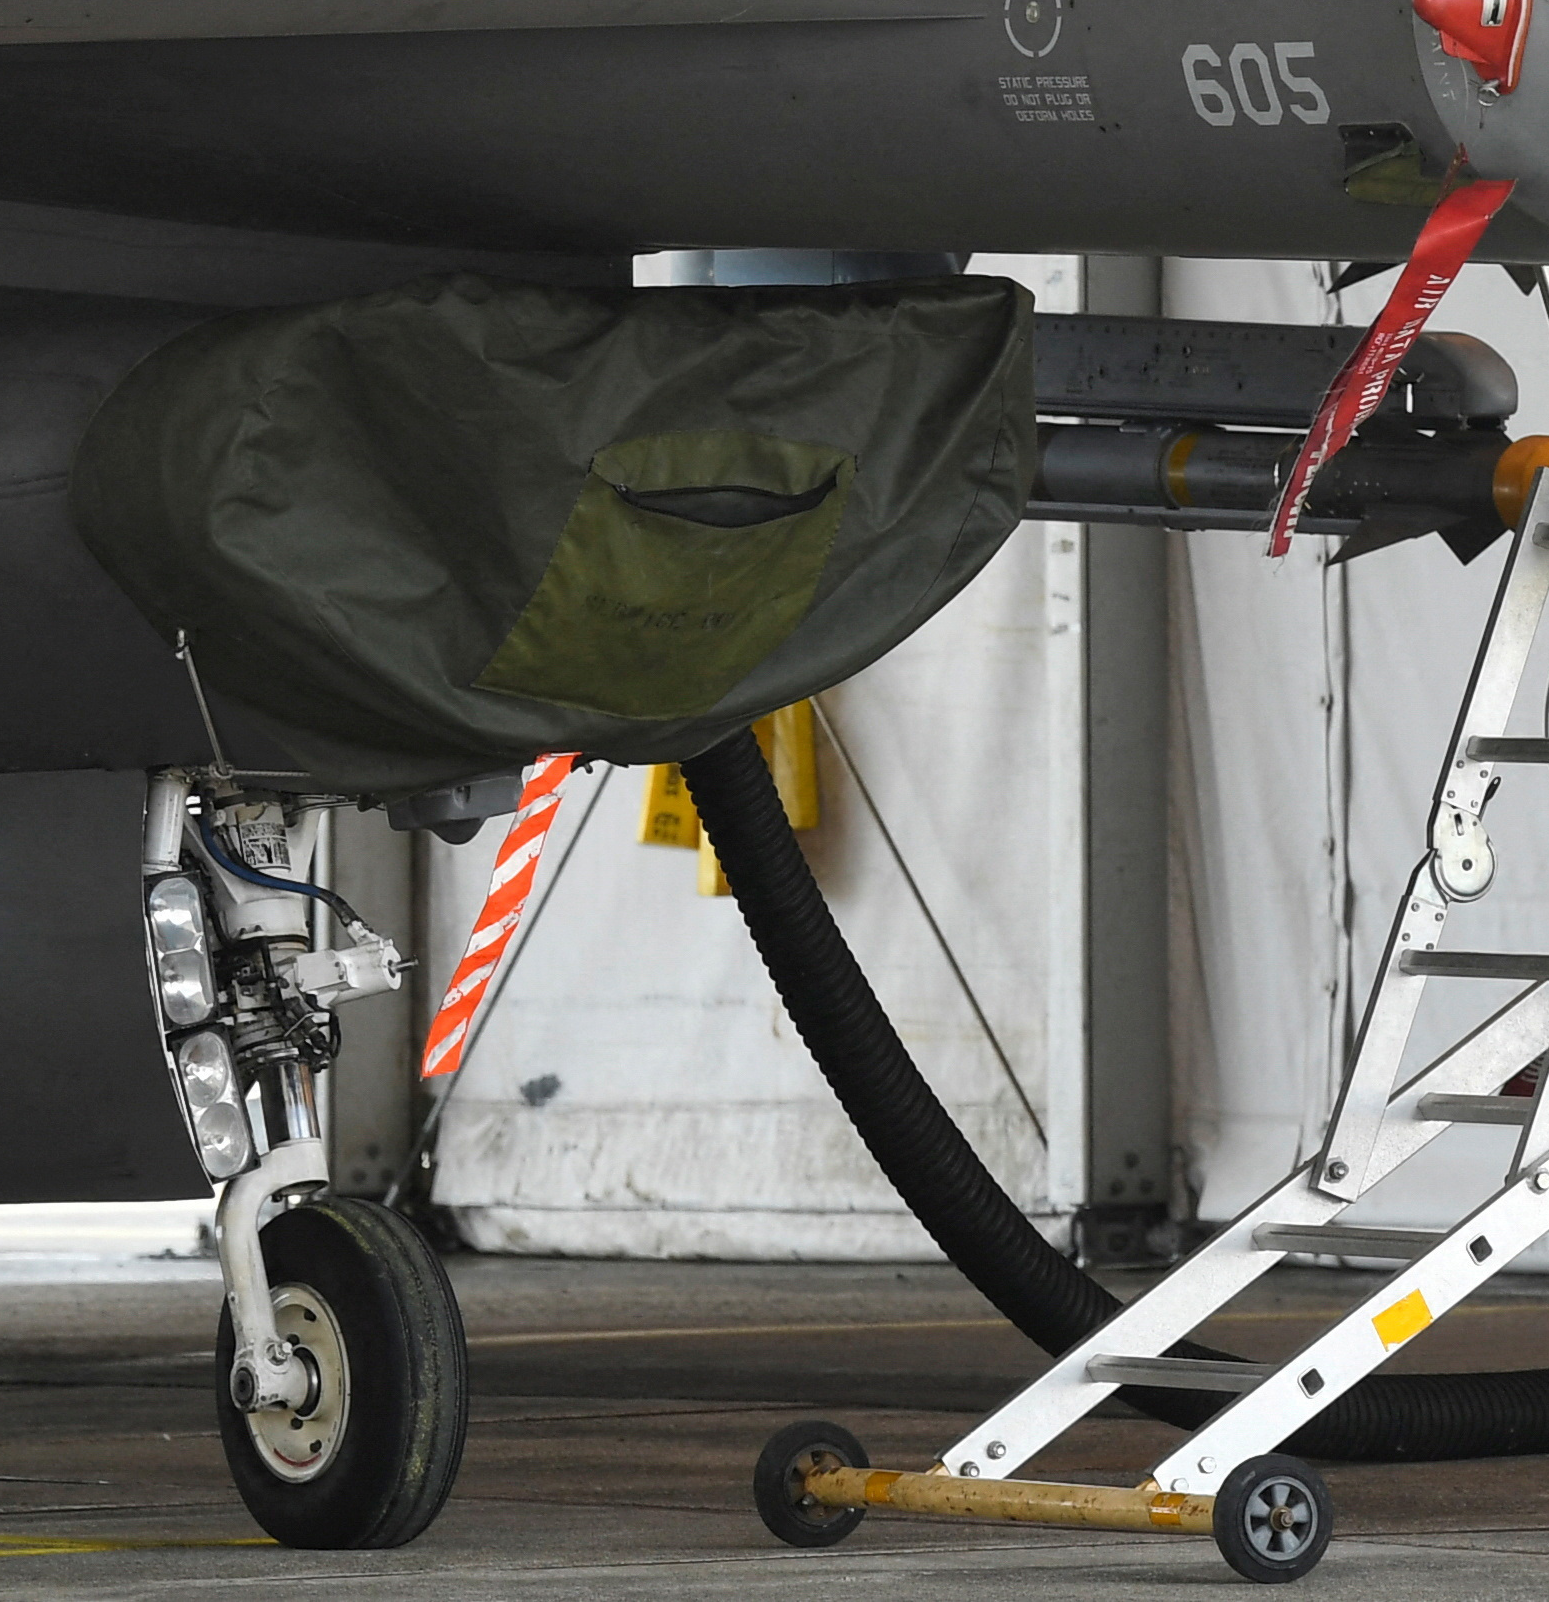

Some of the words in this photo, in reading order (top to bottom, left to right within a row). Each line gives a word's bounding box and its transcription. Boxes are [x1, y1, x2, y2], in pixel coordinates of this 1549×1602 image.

[1432, 29, 1456, 100] AINT
[998, 76, 1033, 89] STATIC
[1035, 76, 1090, 89] PRESSURE
[1181, 41, 1331, 127] 605
[1002, 93, 1019, 106] DO
[1020, 93, 1041, 106] NOT
[1044, 93, 1073, 106] PLUG
[1075, 93, 1092, 105] OR
[1015, 110, 1059, 122] DEFORM
[1060, 109, 1095, 121] HOLES
[1414, 274, 1451, 309] AIR
